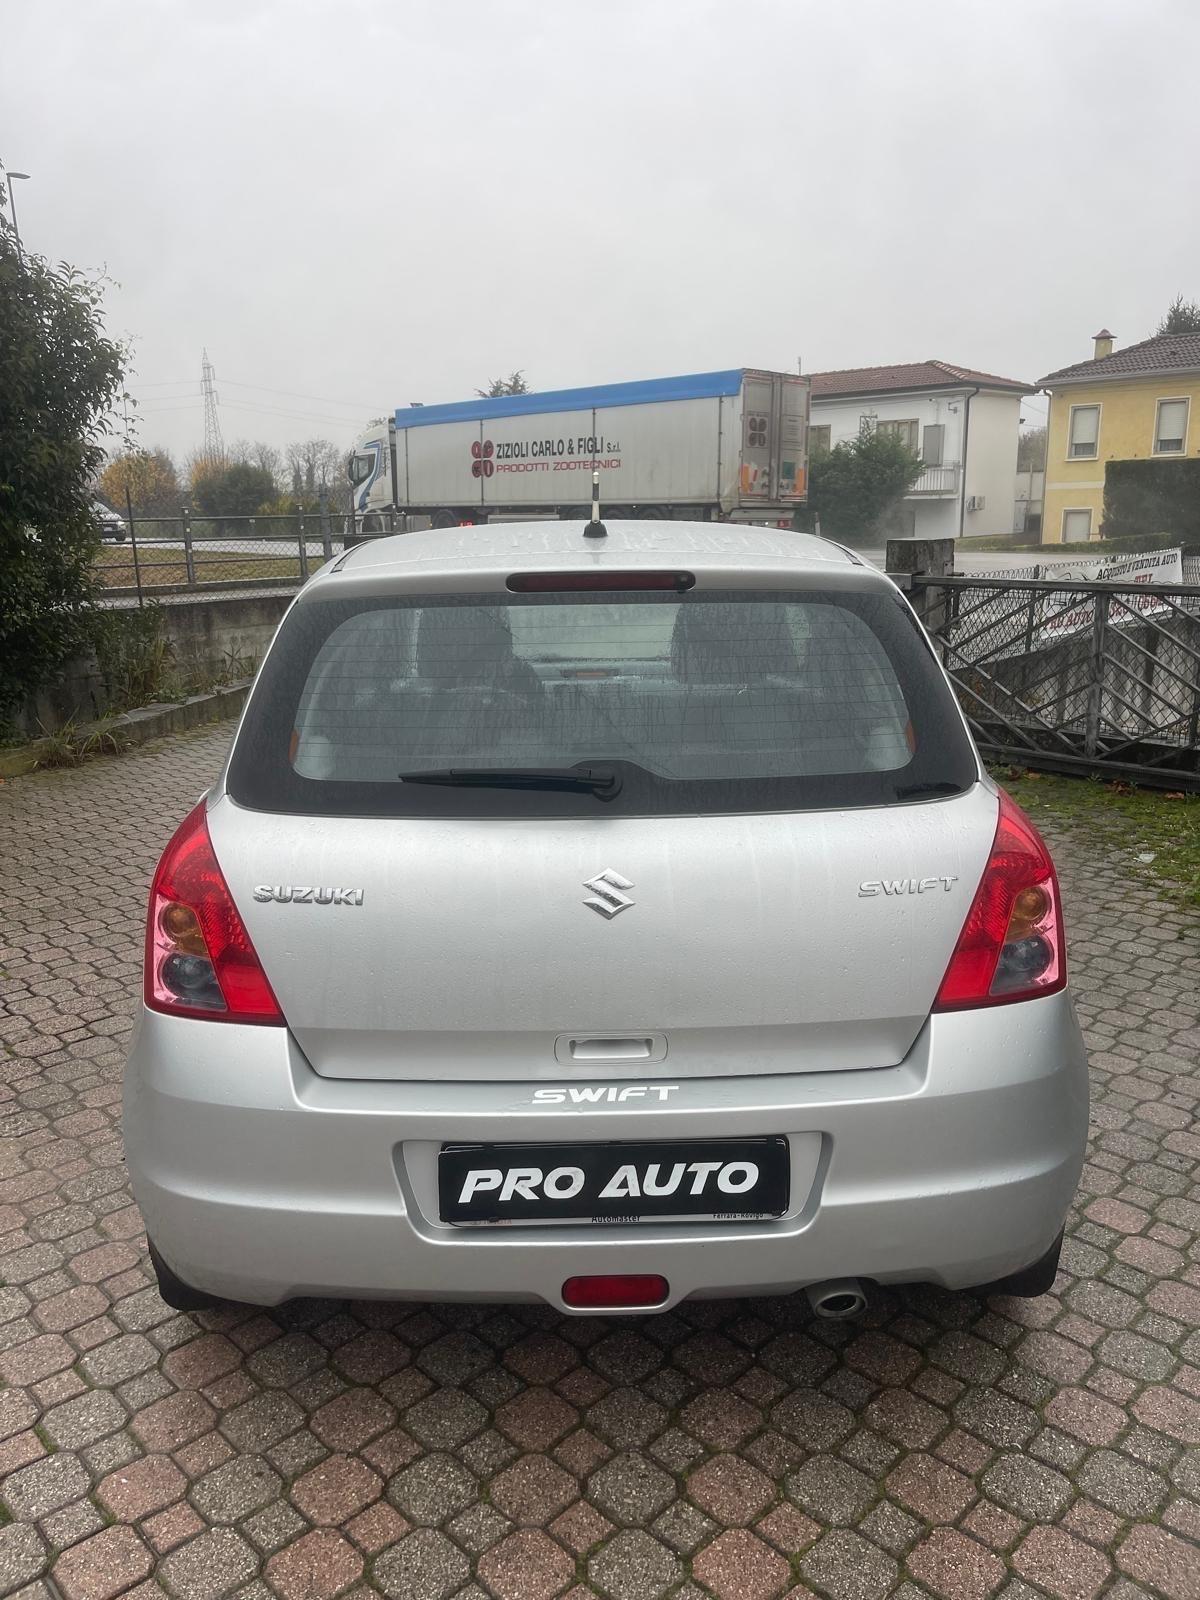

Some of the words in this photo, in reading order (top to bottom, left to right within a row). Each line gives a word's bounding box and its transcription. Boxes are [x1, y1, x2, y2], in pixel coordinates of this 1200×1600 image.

[496, 442, 529, 459] ZIZIOLI
[531, 440, 565, 457] CARLO
[568, 439, 574, 455] &
[577, 436, 604, 454] FIGLI
[496, 462, 549, 473] PRODOTTI
[553, 459, 622, 471] ZOOTECNICI
[1161, 553, 1178, 566] AUTO
[253, 884, 364, 906] SUZUKI
[858, 876, 958, 897] SWIFT
[532, 1085, 680, 1104] SWIFT
[458, 1166, 586, 1203] PRO
[598, 1161, 760, 1198] AUTO
[591, 1215, 641, 1224] Automaster
